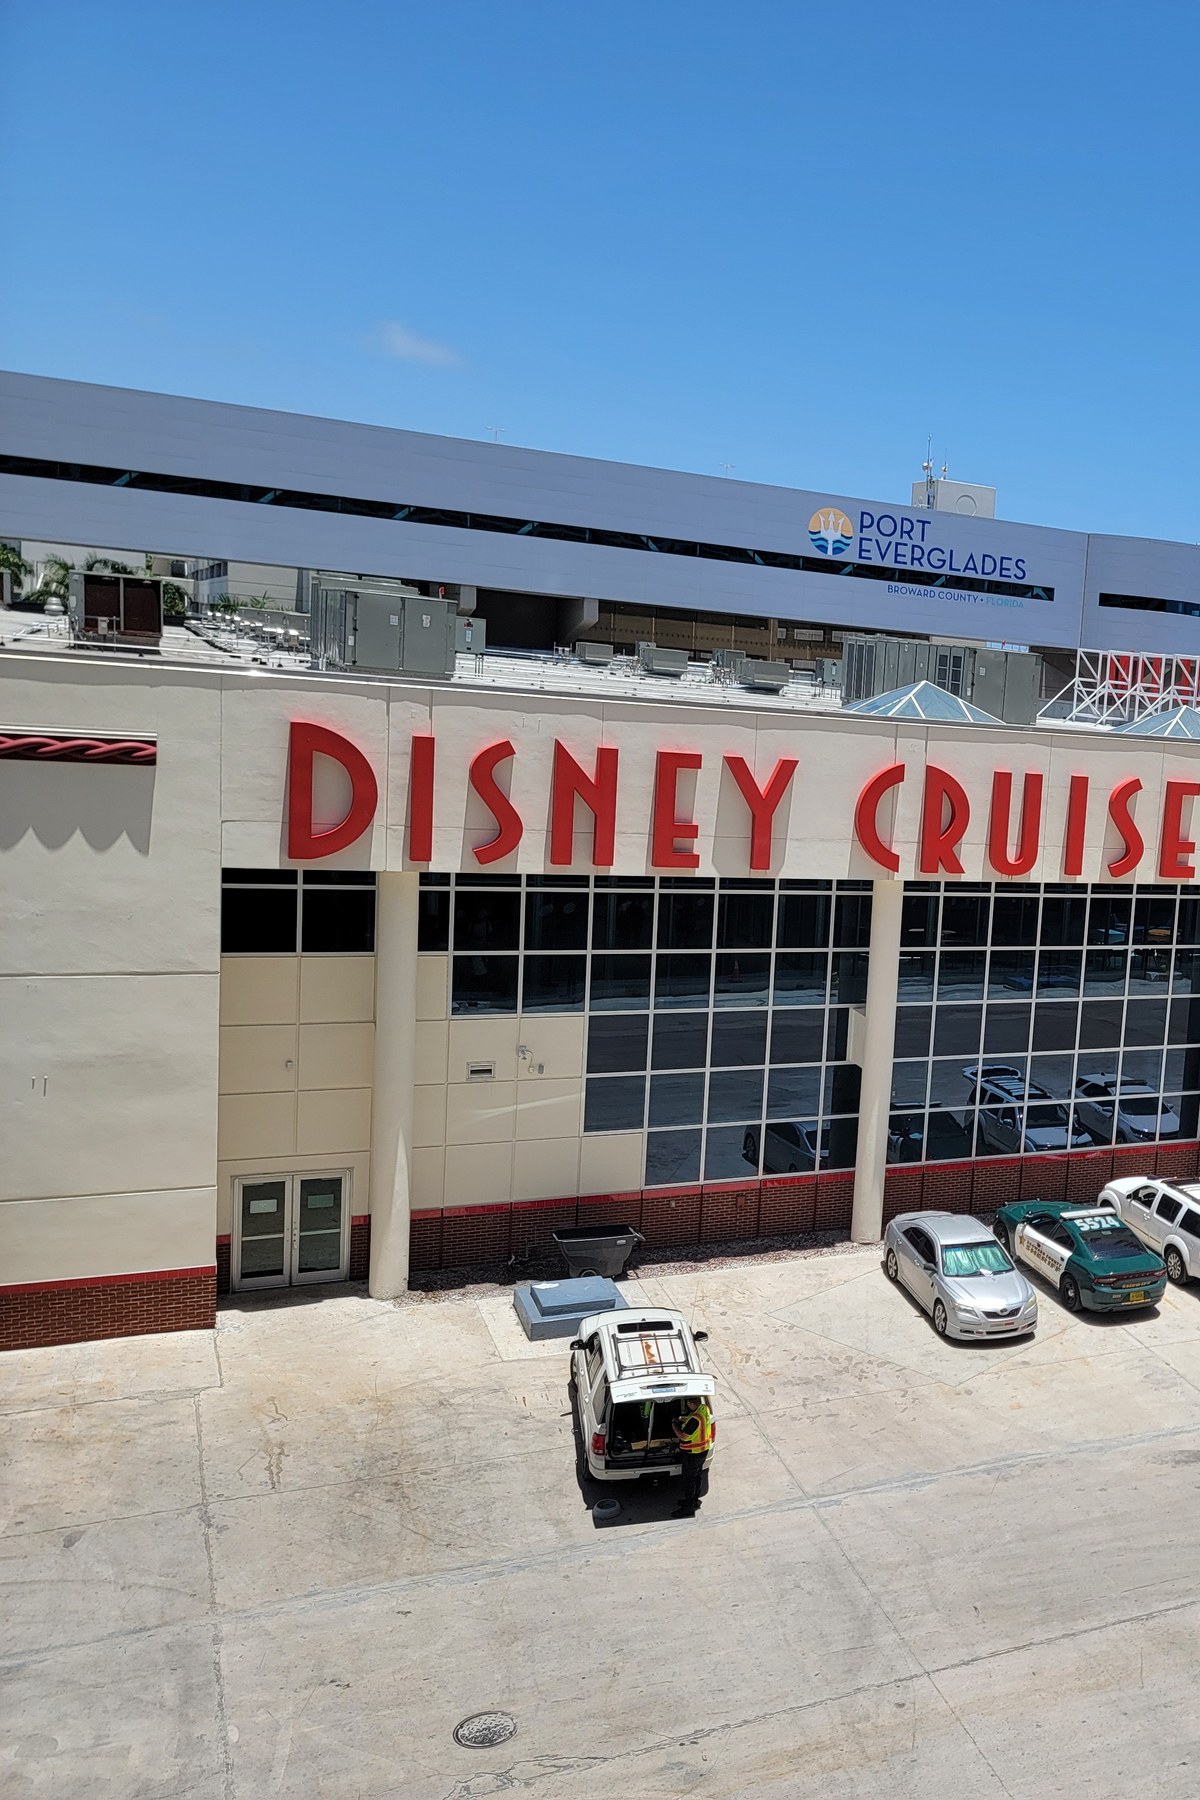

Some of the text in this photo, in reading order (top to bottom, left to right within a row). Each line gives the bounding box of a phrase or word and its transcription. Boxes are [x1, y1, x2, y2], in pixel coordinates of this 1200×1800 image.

[858, 511, 931, 542] PORT
[858, 537, 1027, 580] EVERGLADES
[887, 584, 1024, 609] BROWARD COUNTY FLORIDA
[288, 721, 799, 871] DISNEY
[855, 763, 1200, 878] CRUISE
[1073, 1215, 1121, 1232] 5524
